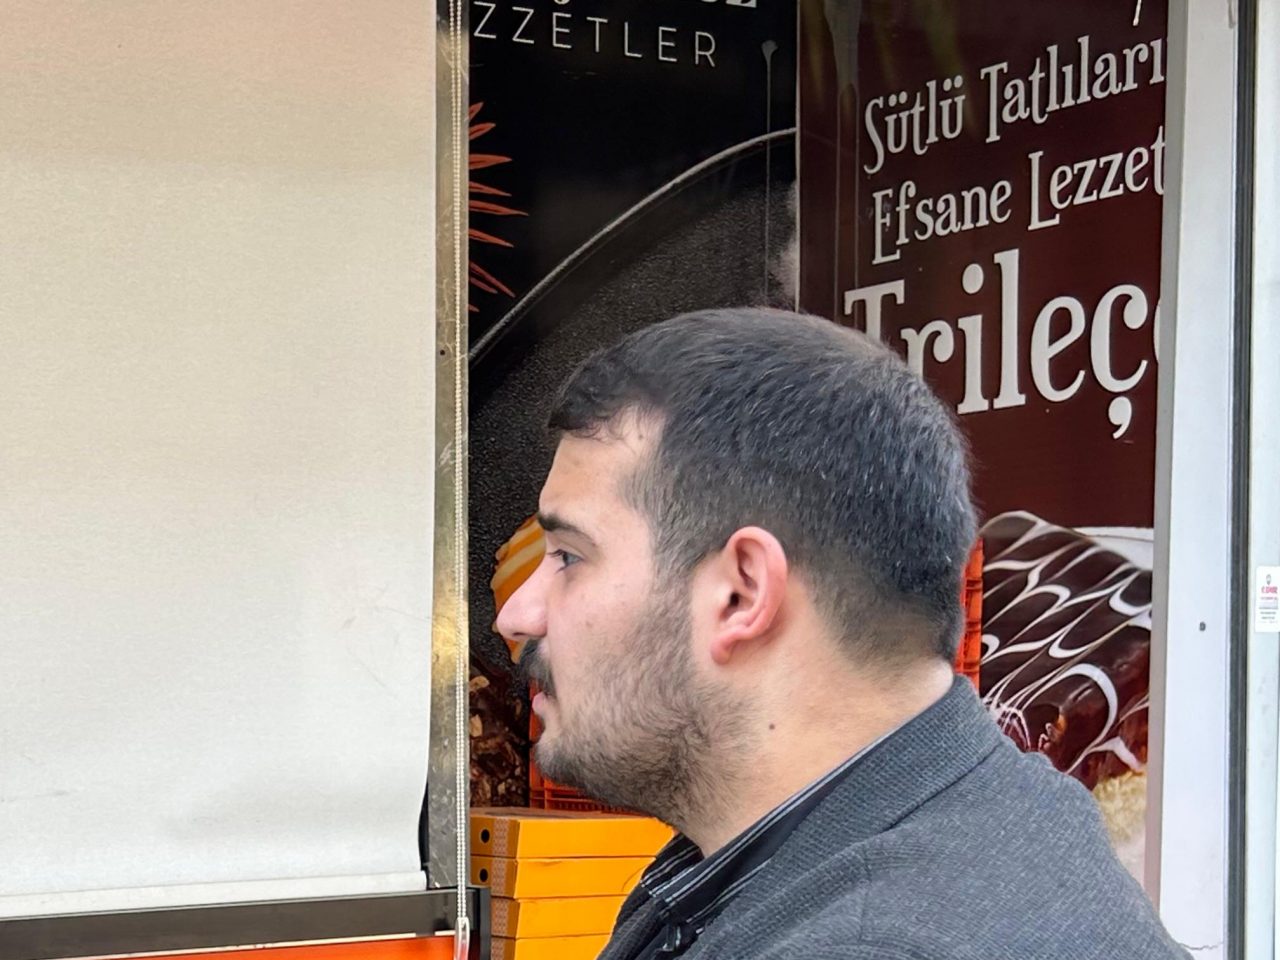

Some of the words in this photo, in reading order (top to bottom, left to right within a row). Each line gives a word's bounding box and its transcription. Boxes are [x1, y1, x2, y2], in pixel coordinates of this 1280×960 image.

[863, 75, 966, 175] Sütlü
[979, 35, 1165, 143] Tatlıları
[872, 180, 1013, 265] Efsane
[1027, 125, 1166, 231] Lezzet
[843, 248, 1162, 440] Trileç
